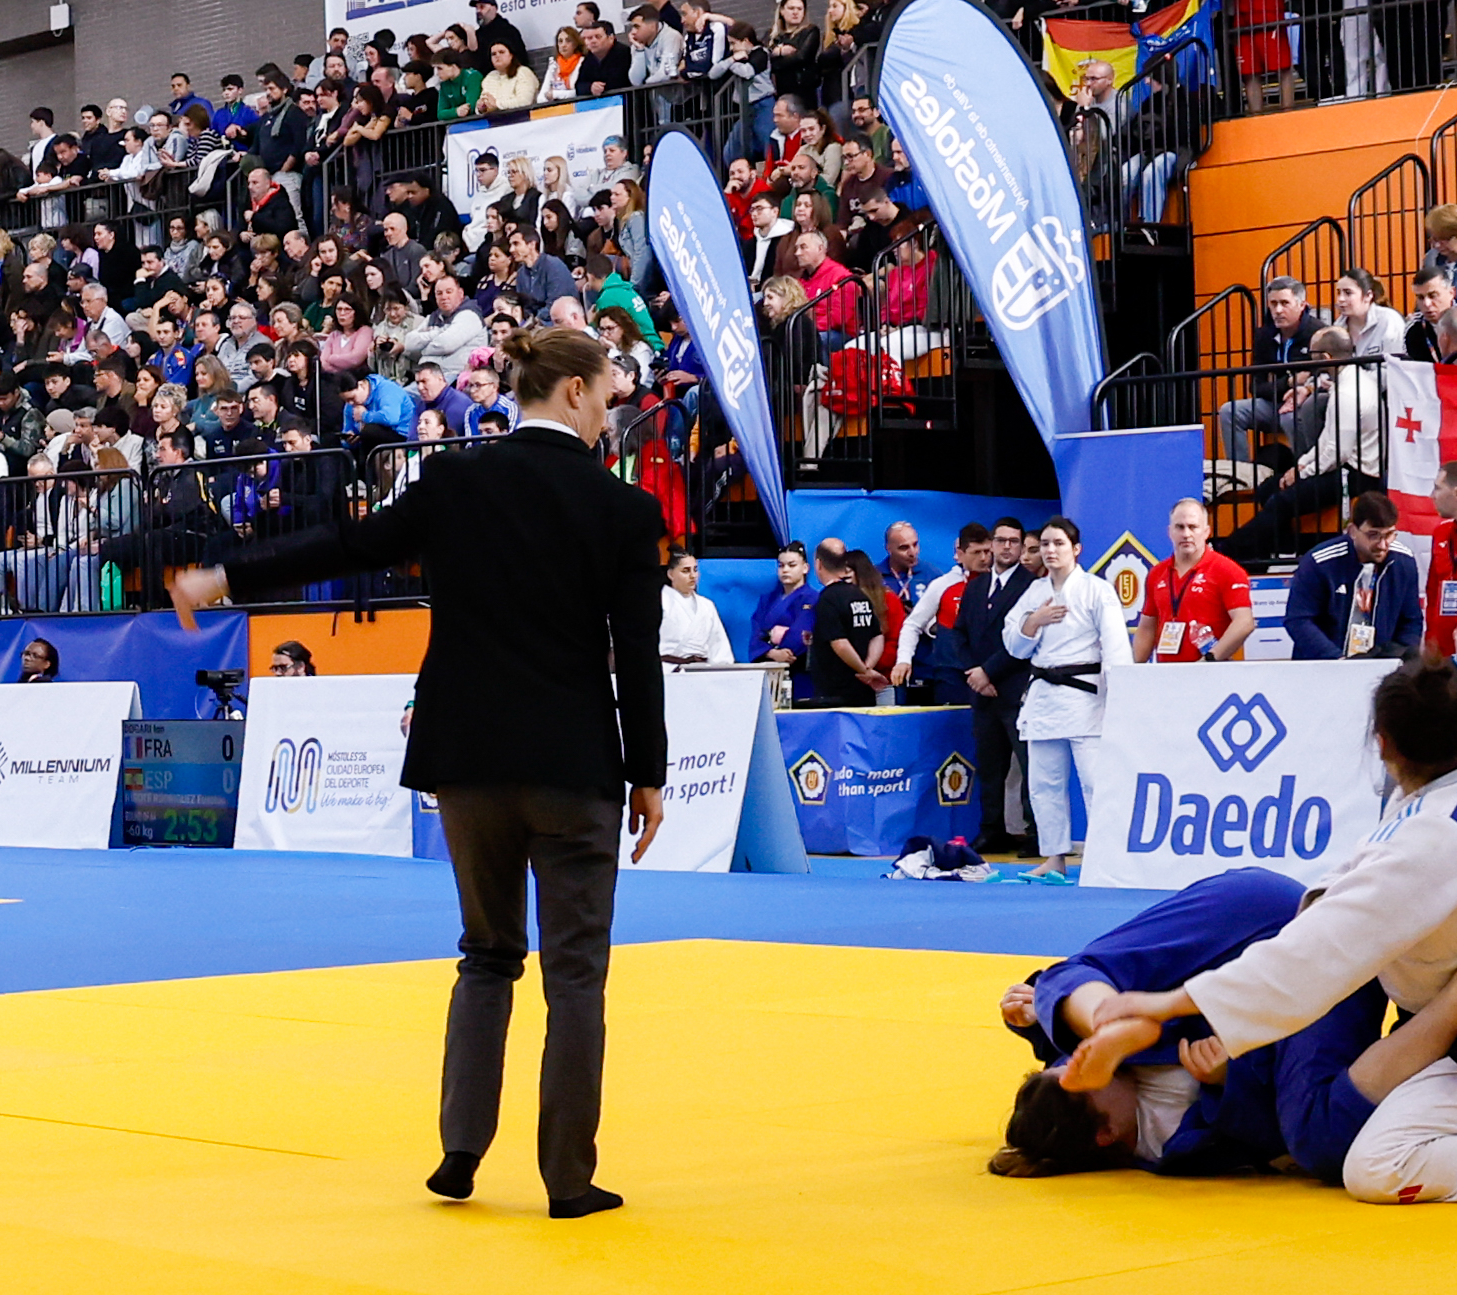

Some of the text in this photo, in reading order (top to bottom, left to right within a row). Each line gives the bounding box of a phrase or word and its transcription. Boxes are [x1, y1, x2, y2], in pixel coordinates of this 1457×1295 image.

[143, 734, 235, 762] FRA 0
[9, 757, 111, 775] MILLENNIUM
[326, 763, 386, 776] CIUDAD EUROPEA
[678, 750, 727, 773] more
[38, 775, 80, 785] TEAM
[144, 767, 235, 795] ESP 0
[324, 777, 370, 789] DEL DEPORTE
[867, 766, 905, 780] more
[679, 771, 737, 801] sport!
[838, 777, 911, 797] than sport!
[126, 824, 141, 837] -60
[142, 824, 154, 840] kg
[163, 808, 219, 842] 2:53
[1127, 772, 1332, 861] Daedo
